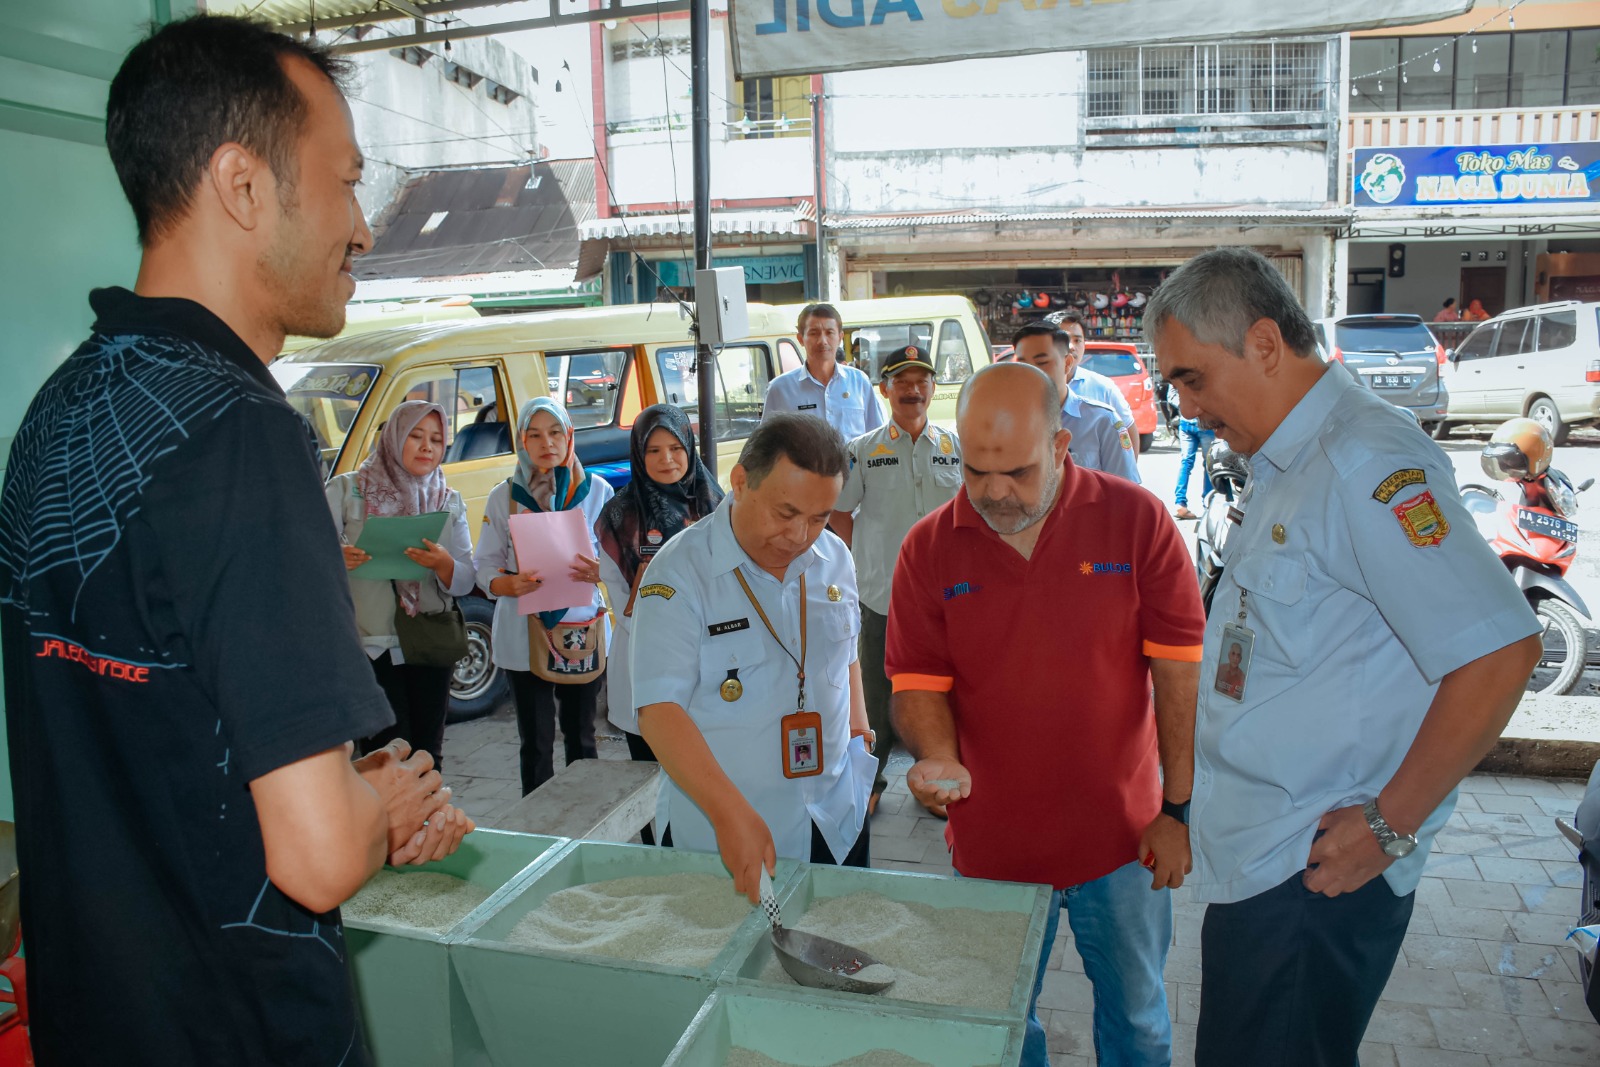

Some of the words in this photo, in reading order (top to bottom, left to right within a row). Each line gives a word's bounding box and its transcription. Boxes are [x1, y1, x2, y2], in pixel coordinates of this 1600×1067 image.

[1457, 151, 1504, 175] Toko
[1506, 147, 1552, 171] Mas
[1416, 174, 1498, 201] NAGA
[1501, 173, 1590, 199] DUNIA
[867, 457, 899, 468] SAEFUDIN
[932, 456, 949, 465] POL
[1375, 470, 1423, 498] PEMERINTAH
[1519, 510, 1533, 522] AA
[1536, 515, 1562, 529] 2576
[1565, 522, 1578, 533] BP
